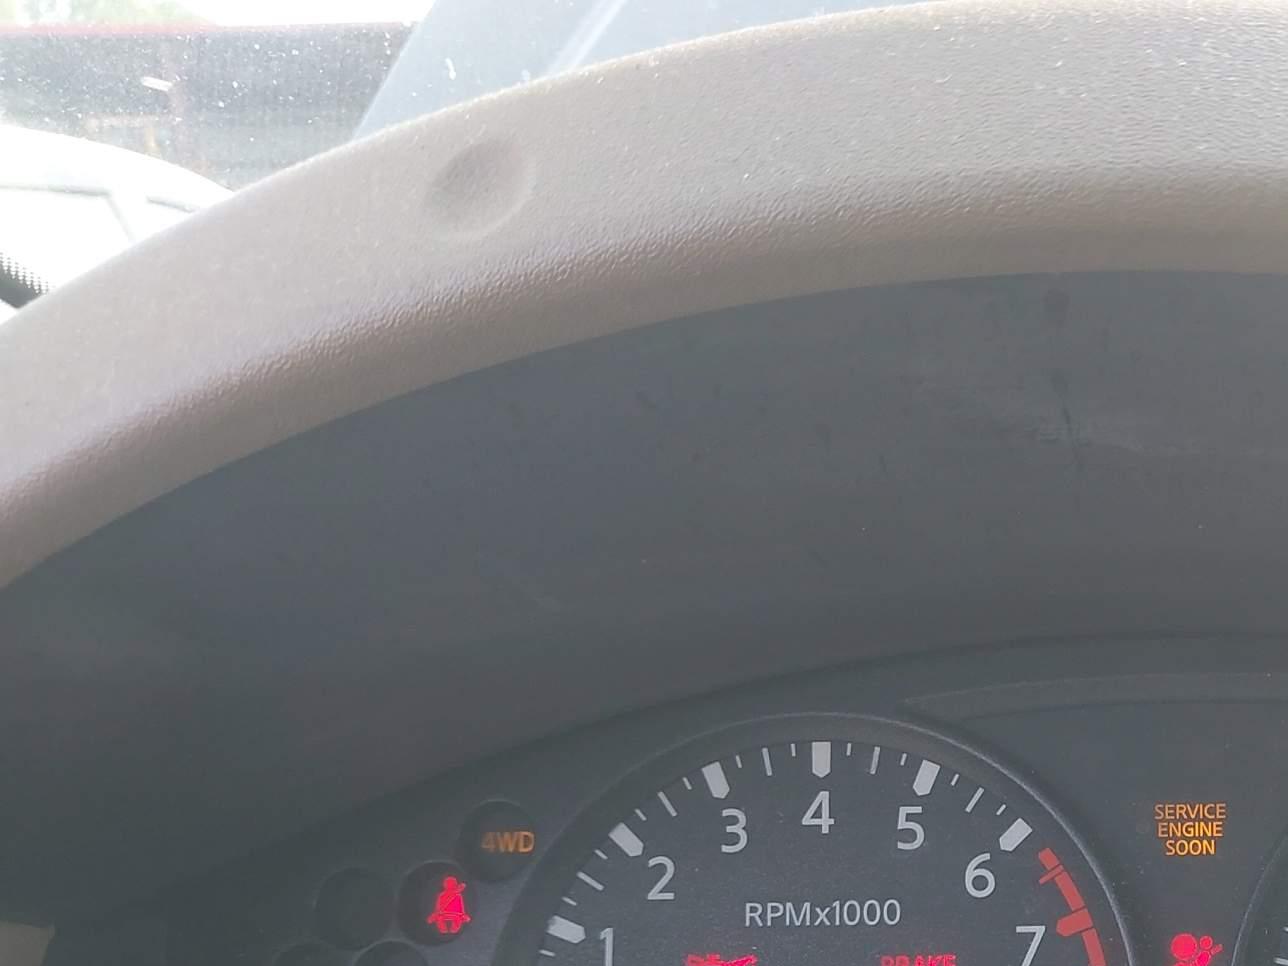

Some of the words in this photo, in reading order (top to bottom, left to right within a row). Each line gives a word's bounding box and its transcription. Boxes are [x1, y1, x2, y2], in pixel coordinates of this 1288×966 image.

[801, 791, 835, 834] 4
[896, 806, 925, 850] 5
[1154, 803, 1226, 820] SERVICE
[481, 831, 535, 854] 4WD
[720, 808, 749, 852] 3
[1157, 822, 1223, 838] ENGINE
[1165, 840, 1216, 856] SOON
[647, 856, 676, 900] 2
[964, 853, 995, 898] 6
[744, 899, 901, 928] RPMx1000
